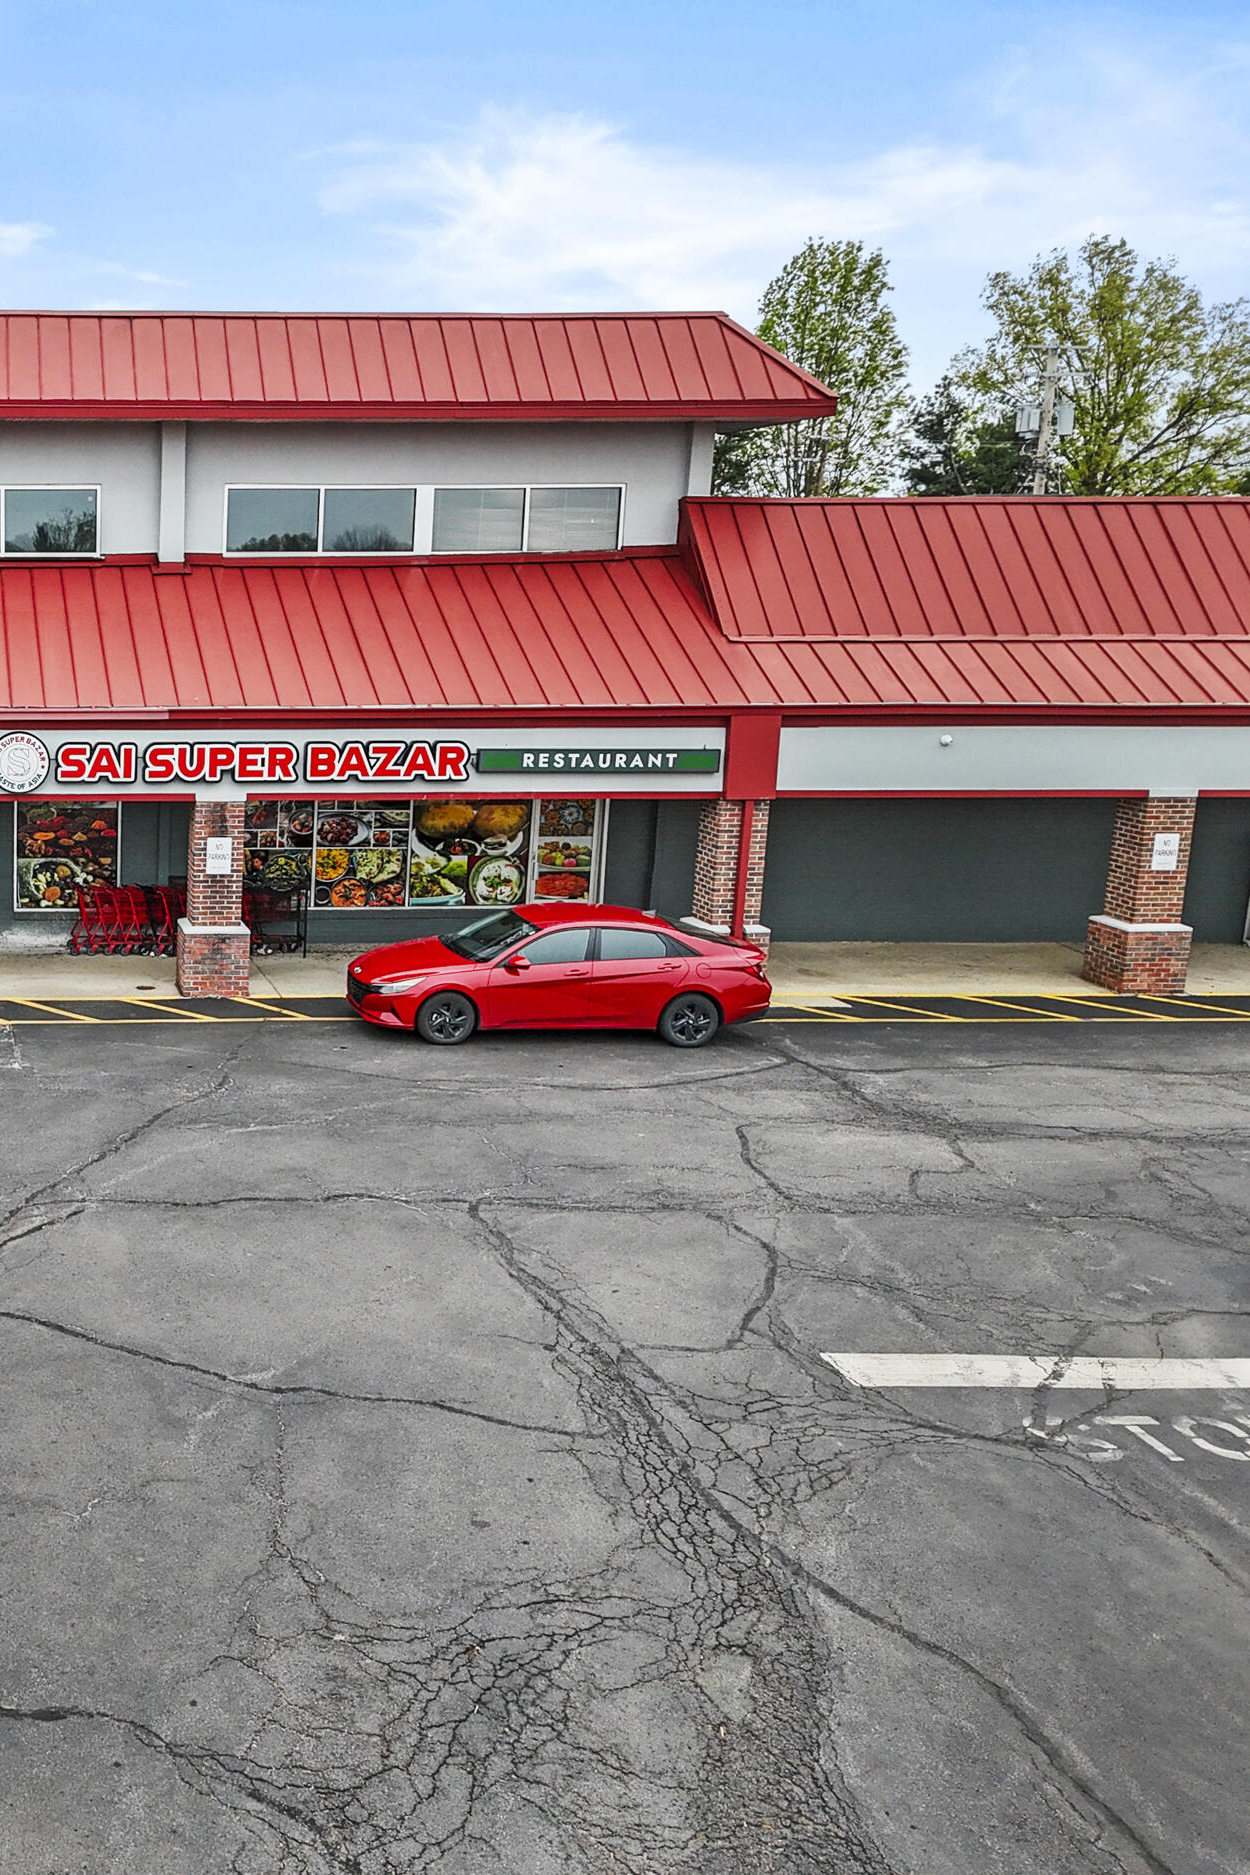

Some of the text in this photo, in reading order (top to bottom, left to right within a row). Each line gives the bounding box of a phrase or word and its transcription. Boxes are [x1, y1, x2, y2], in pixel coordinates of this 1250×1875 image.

[1, 736, 25, 748] SUPER
[26, 738, 46, 761] BAZAR
[522, 752, 679, 769] RESTAURANT
[58, 743, 468, 781] SAI SUPER BAZAR
[28, 773, 43, 787] ASIA
[1022, 1414, 1250, 1463] STO
